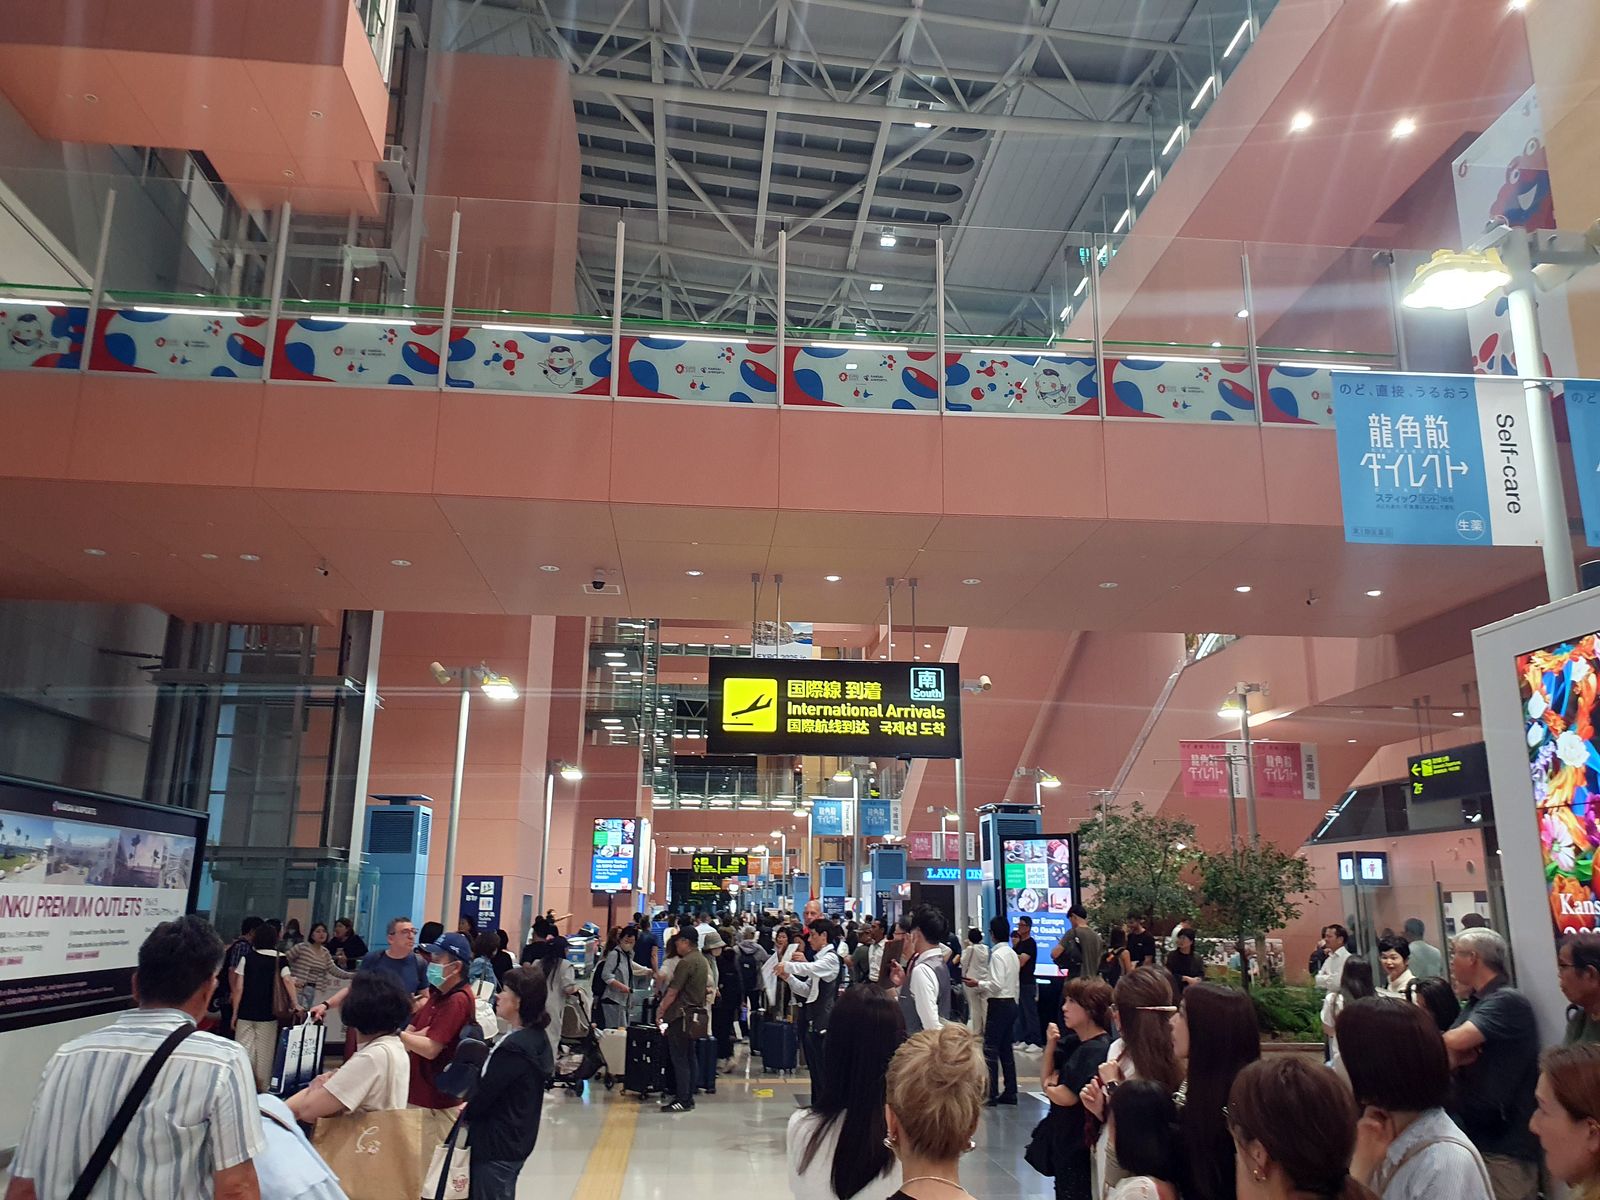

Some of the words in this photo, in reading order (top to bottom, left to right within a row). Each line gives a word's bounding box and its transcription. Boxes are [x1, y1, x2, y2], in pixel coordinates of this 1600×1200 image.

[1368, 413, 1451, 449] 龍角散
[1360, 453, 1470, 489] ダイレクト
[1496, 413, 1521, 515] Self-care
[917, 670, 937, 689] 南
[787, 680, 842, 699] 国際線
[845, 682, 881, 700] 到着
[913, 687, 942, 699] South
[787, 701, 883, 718] International
[885, 704, 946, 719] Arrivals
[879, 721, 918, 736] 국제선
[919, 722, 946, 737] 도착
[1413, 782, 1424, 794] 2F
[927, 867, 983, 880] LAWON
[36, 895, 93, 918] PREMIUM
[95, 896, 143, 918] OUTLETS
